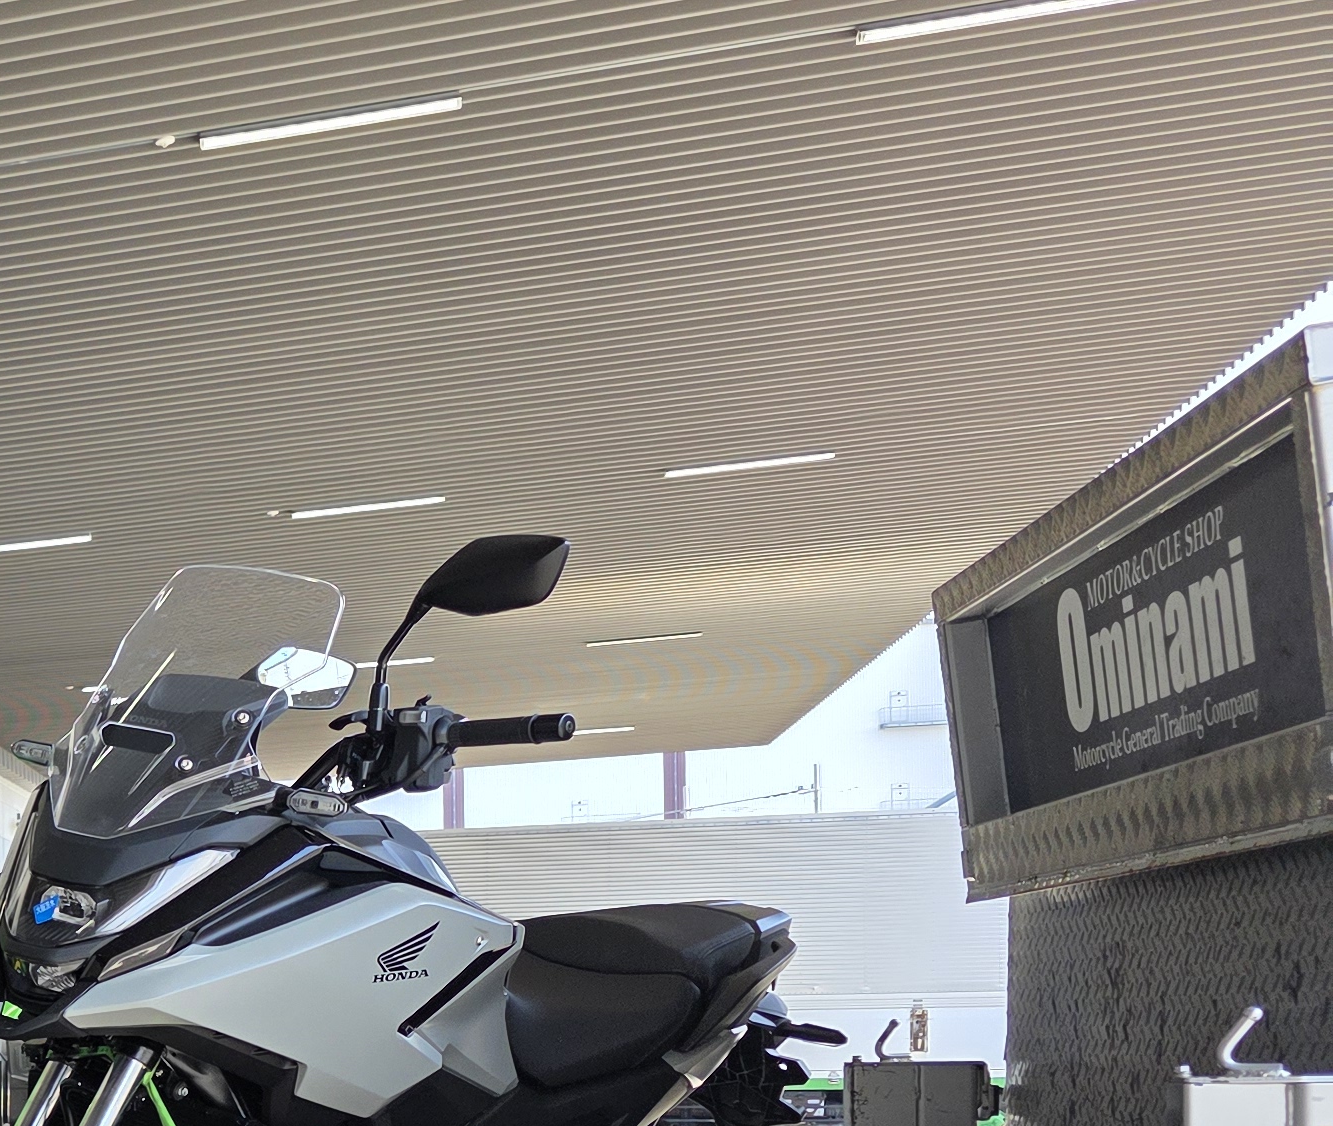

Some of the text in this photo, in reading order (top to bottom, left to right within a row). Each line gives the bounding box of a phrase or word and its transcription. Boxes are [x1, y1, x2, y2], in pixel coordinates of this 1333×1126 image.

[1086, 505, 1224, 611] MOTOR&CYCLE SHOP
[1057, 536, 1256, 732] Ominami
[1073, 689, 1259, 771] Motorcycle General Trading Company
[372, 969, 429, 983] HONDA
